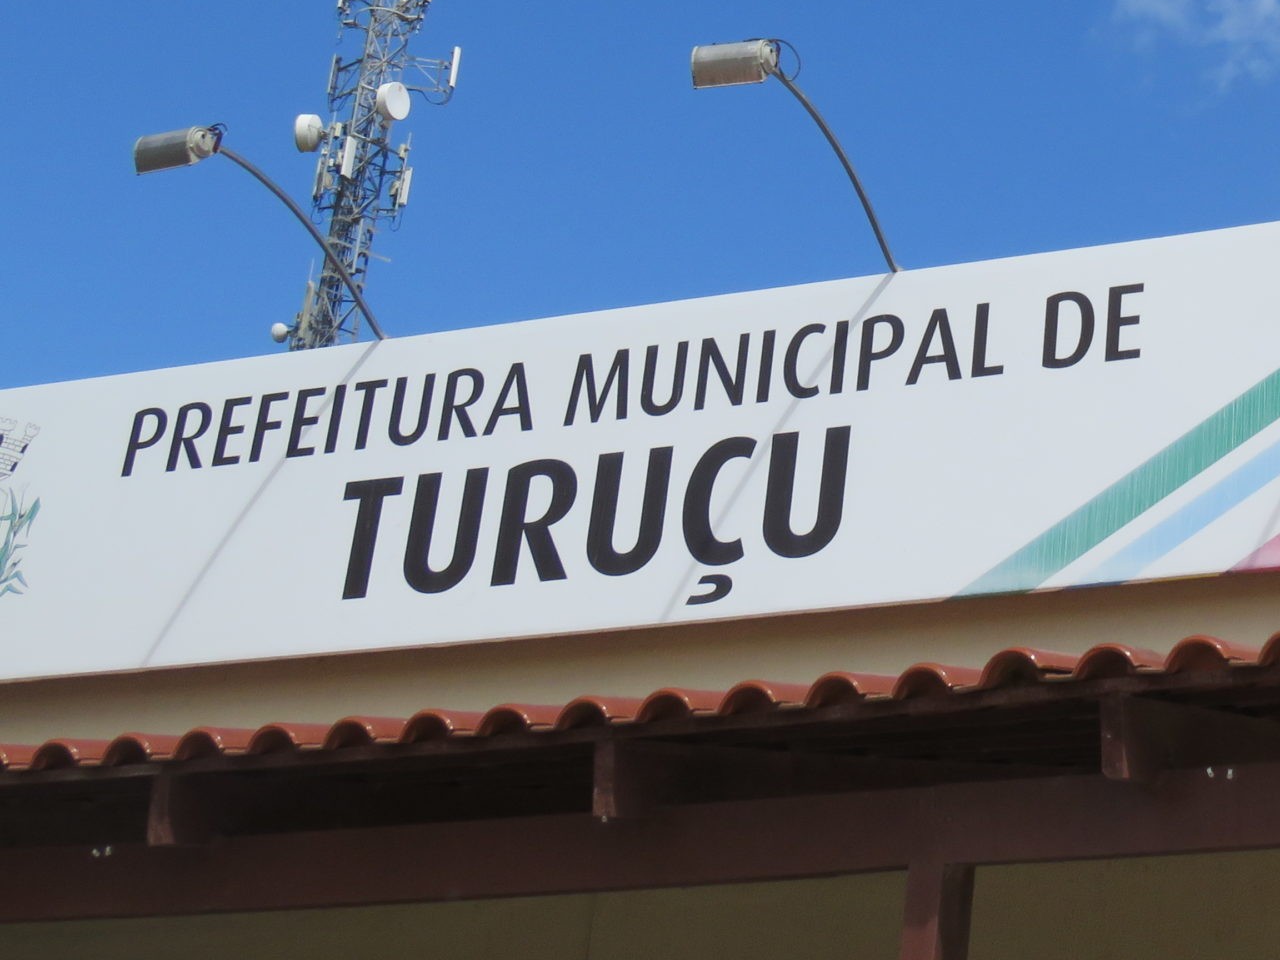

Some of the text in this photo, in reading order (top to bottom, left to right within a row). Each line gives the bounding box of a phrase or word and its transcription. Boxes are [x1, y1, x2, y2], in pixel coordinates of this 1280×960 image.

[121, 283, 1144, 477] PREFEITURA MUNICIPAL DE
[342, 425, 851, 605] TURUÇU
